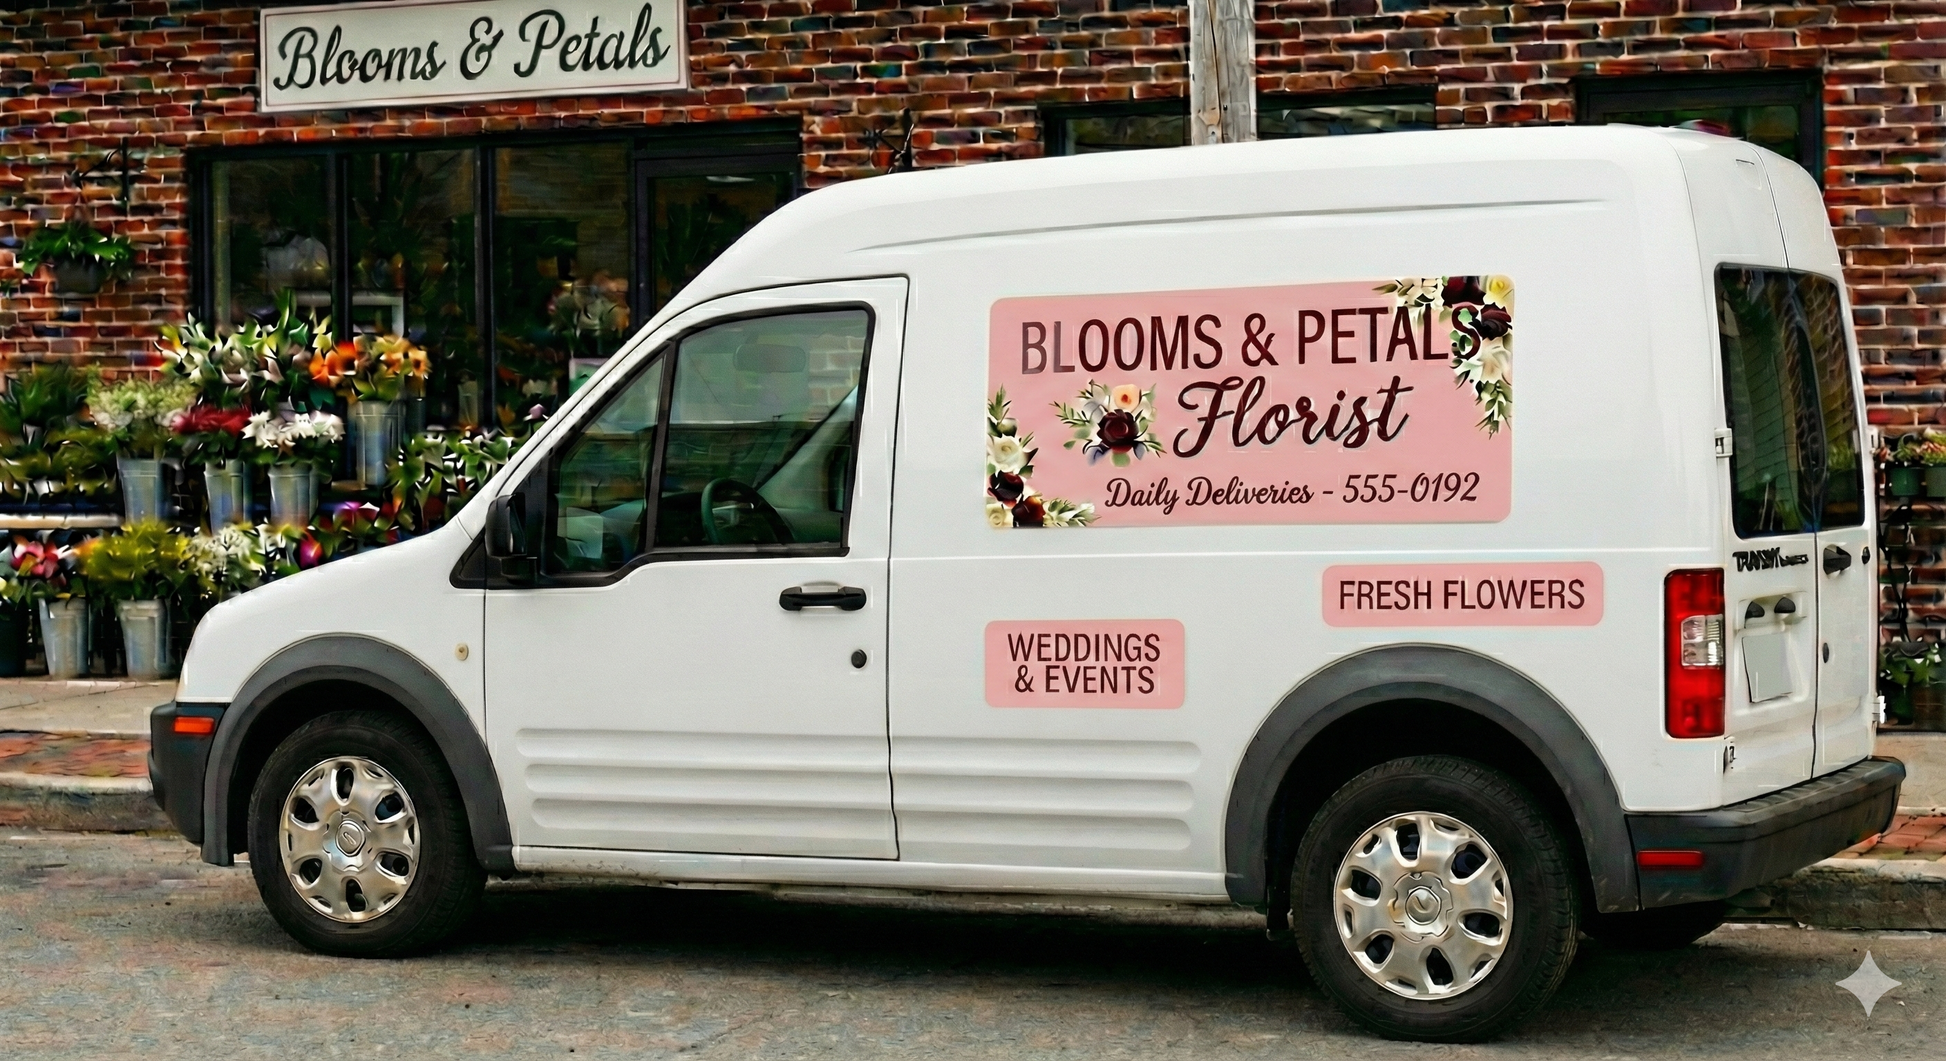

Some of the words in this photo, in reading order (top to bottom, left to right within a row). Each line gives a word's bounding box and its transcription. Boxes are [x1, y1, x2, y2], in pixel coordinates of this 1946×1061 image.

[273, 25, 446, 91] Blooms
[459, 16, 505, 81] &
[513, 2, 671, 78] Petals
[1021, 313, 1223, 375] BLOOMS
[1241, 312, 1280, 367] &
[1298, 303, 1482, 365] PETALS
[1172, 375, 1415, 458] Florist
[1104, 476, 1181, 516] Daily
[1184, 475, 1315, 507] Deliveries
[1342, 471, 1481, 504] 555-0192
[1339, 580, 1432, 611] FRESH
[1443, 578, 1586, 610] FLOWERS
[1007, 632, 1161, 663] WEDDINGS
[1014, 664, 1035, 693] &
[1045, 664, 1155, 695] EVENTS
